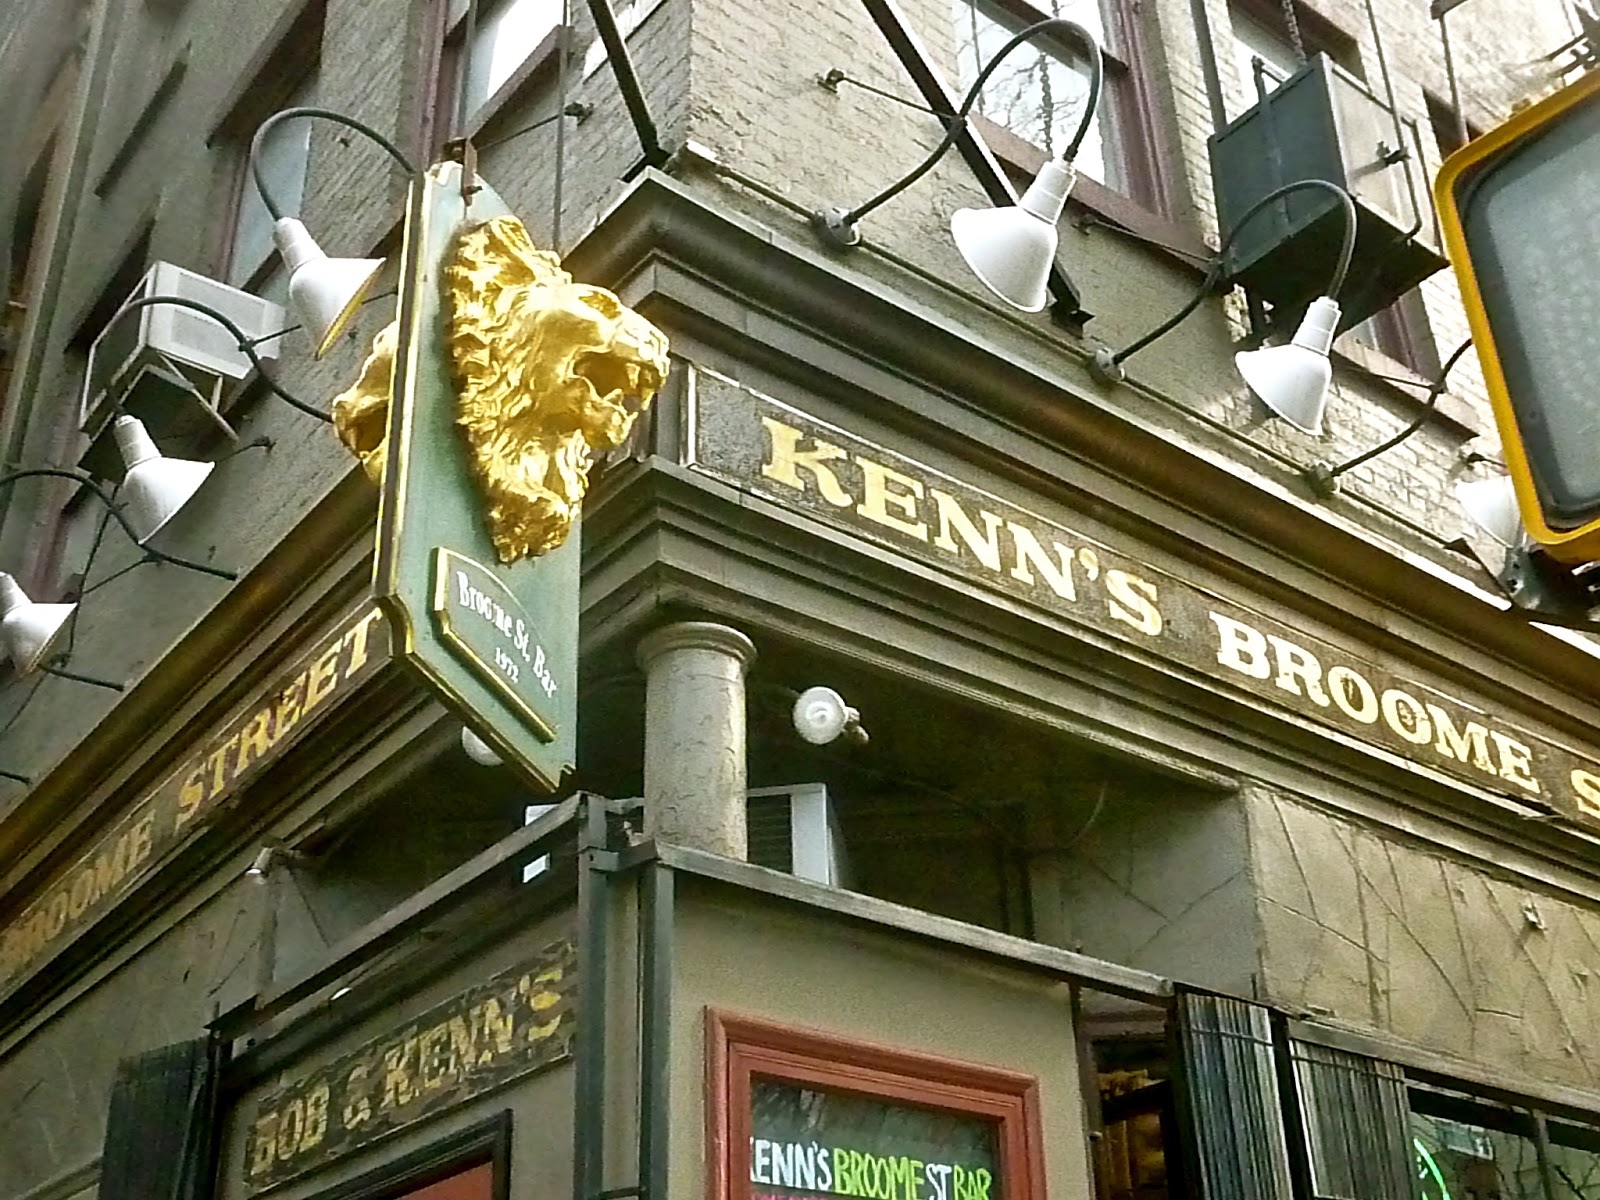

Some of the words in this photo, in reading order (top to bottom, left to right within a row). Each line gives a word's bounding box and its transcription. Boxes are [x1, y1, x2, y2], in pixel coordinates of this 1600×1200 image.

[457, 570, 513, 637] Broome
[532, 645, 558, 698] Bar
[761, 416, 1163, 637] KENN'S
[1208, 610, 1541, 794] BROOME
[174, 606, 384, 837] STREET
[749, 1136, 832, 1191] ENN'S
[833, 1147, 925, 1200] BROOME
[953, 1164, 993, 1200] BAR
